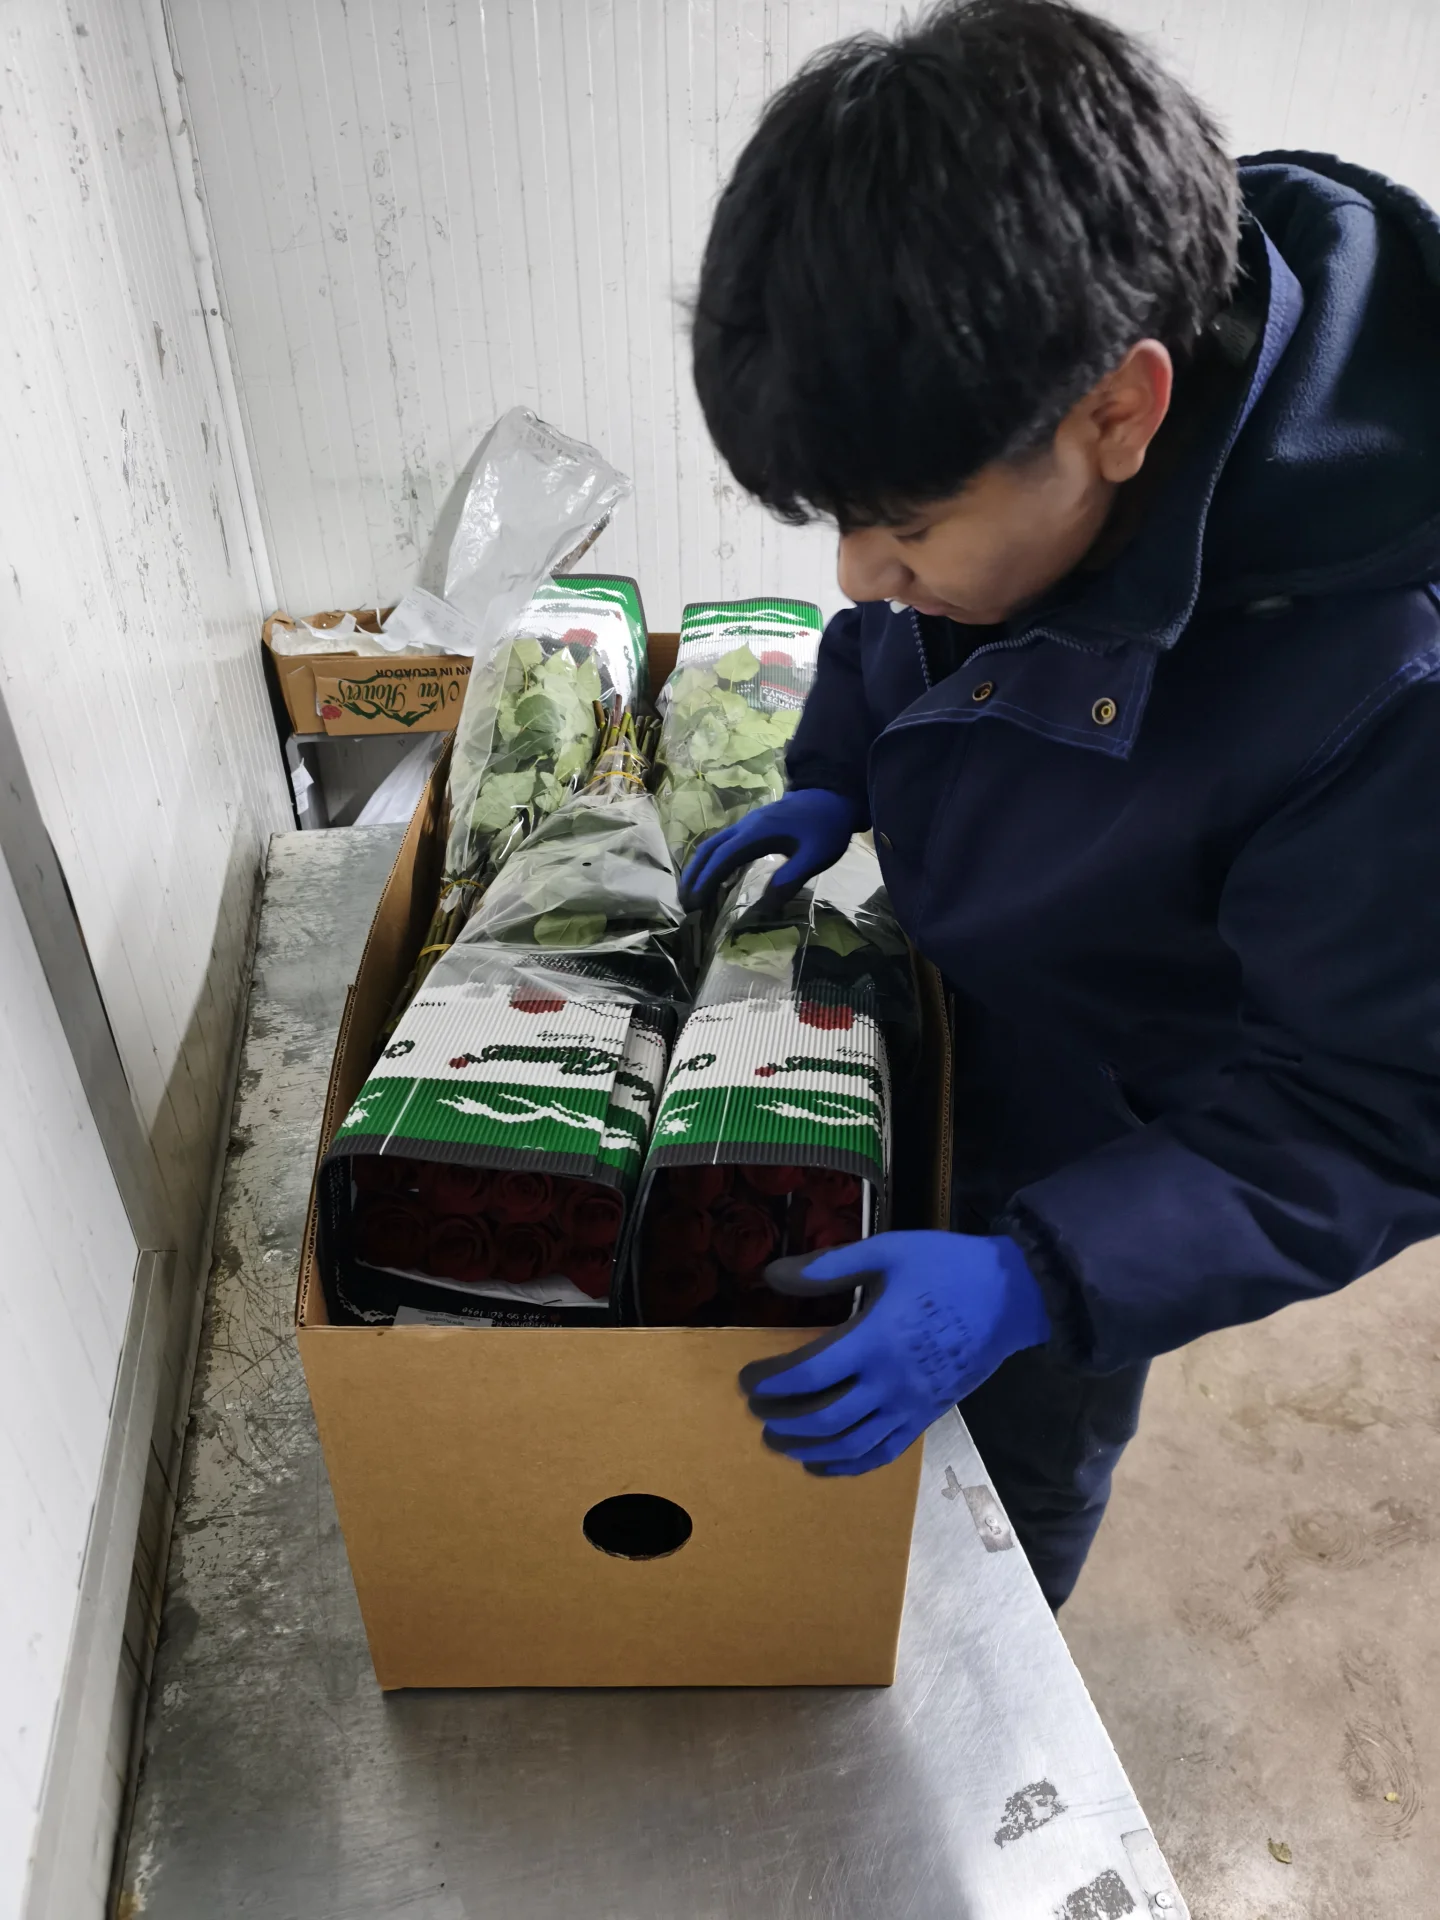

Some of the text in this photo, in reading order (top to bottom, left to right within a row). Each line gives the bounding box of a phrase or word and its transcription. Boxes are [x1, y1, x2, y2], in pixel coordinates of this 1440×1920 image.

[375, 667, 436, 678] ECUADOR
[440, 667, 453, 677] IN
[338, 680, 460, 712] New Flowers
